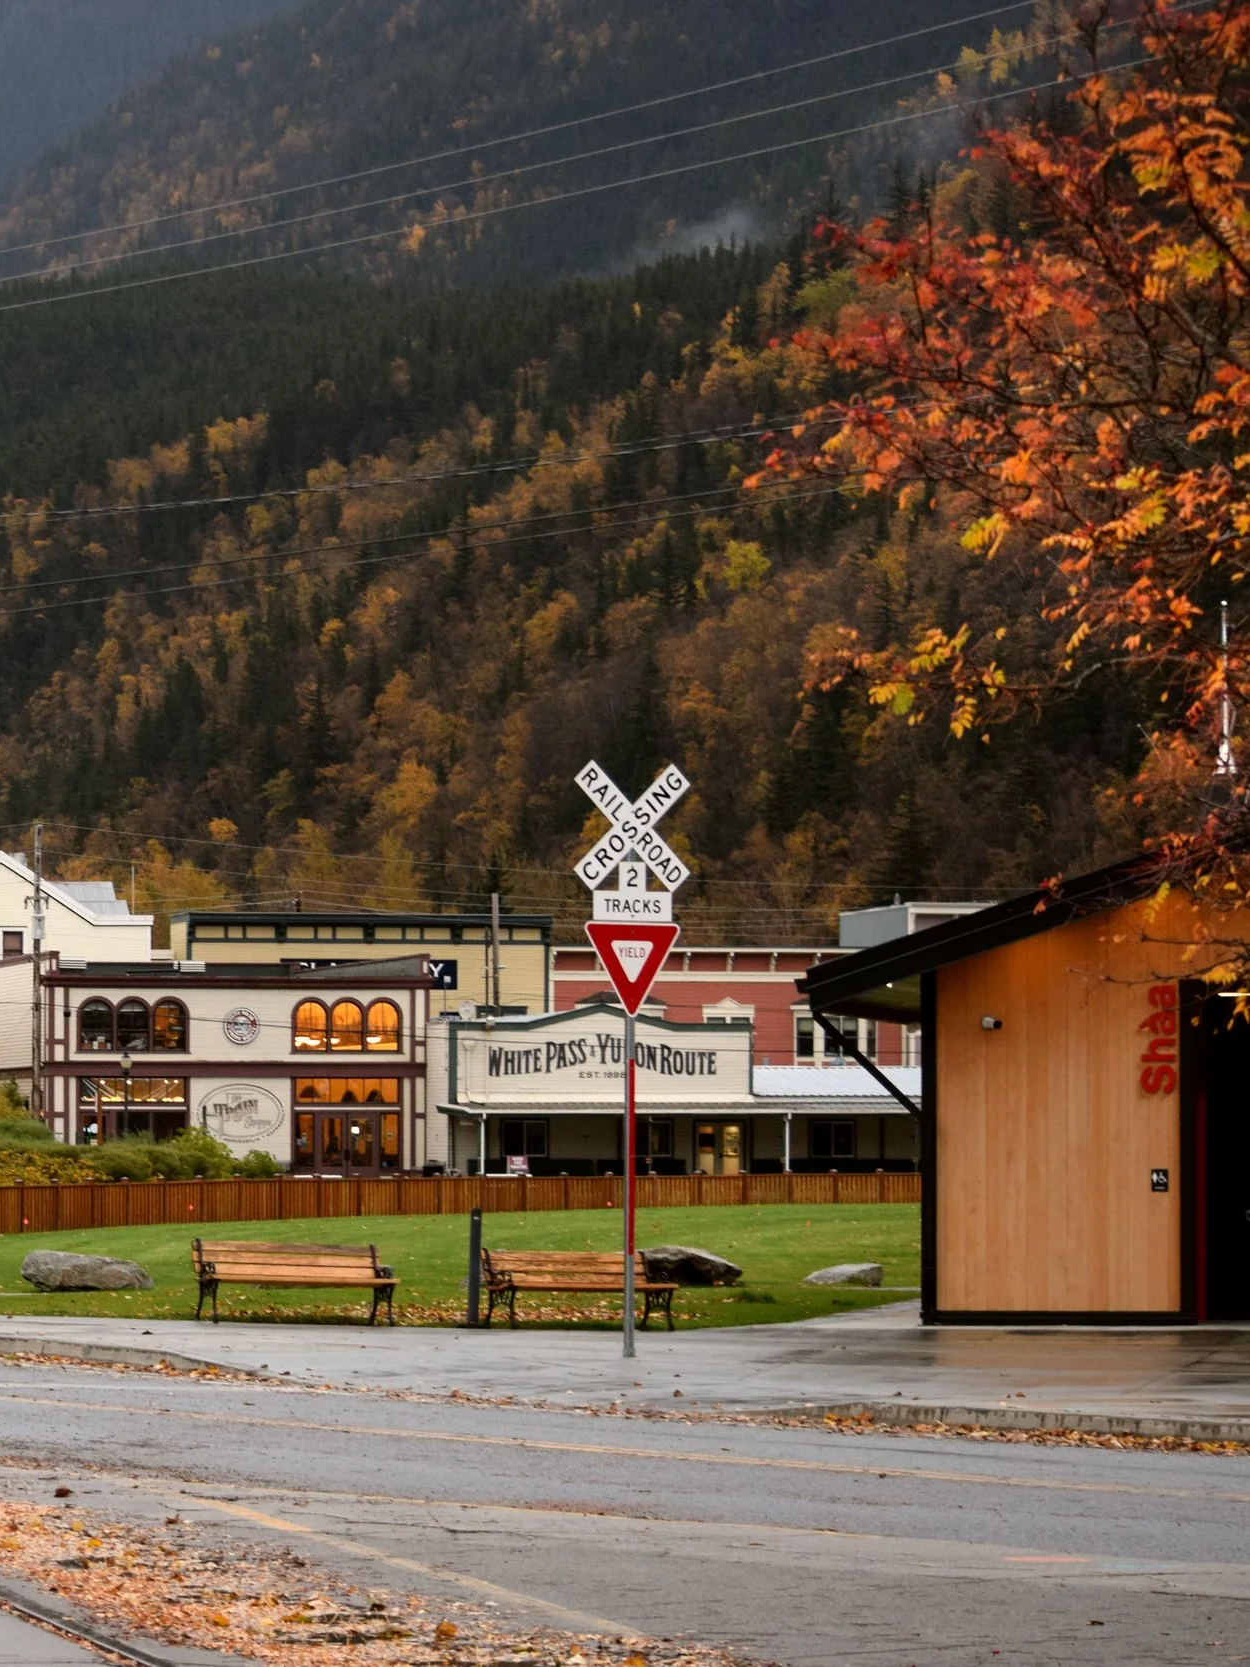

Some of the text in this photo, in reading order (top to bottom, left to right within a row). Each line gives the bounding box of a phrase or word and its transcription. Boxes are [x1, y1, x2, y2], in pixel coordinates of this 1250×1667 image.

[582, 772, 683, 880] CROSSING
[626, 868, 639, 887] 2
[604, 898, 662, 914] TRACKS
[618, 946, 646, 959] YIELD
[488, 1045, 542, 1078] WHITE
[545, 1038, 587, 1074] PASS
[595, 1033, 657, 1071] YUON
[659, 1043, 717, 1076] ROUTE
